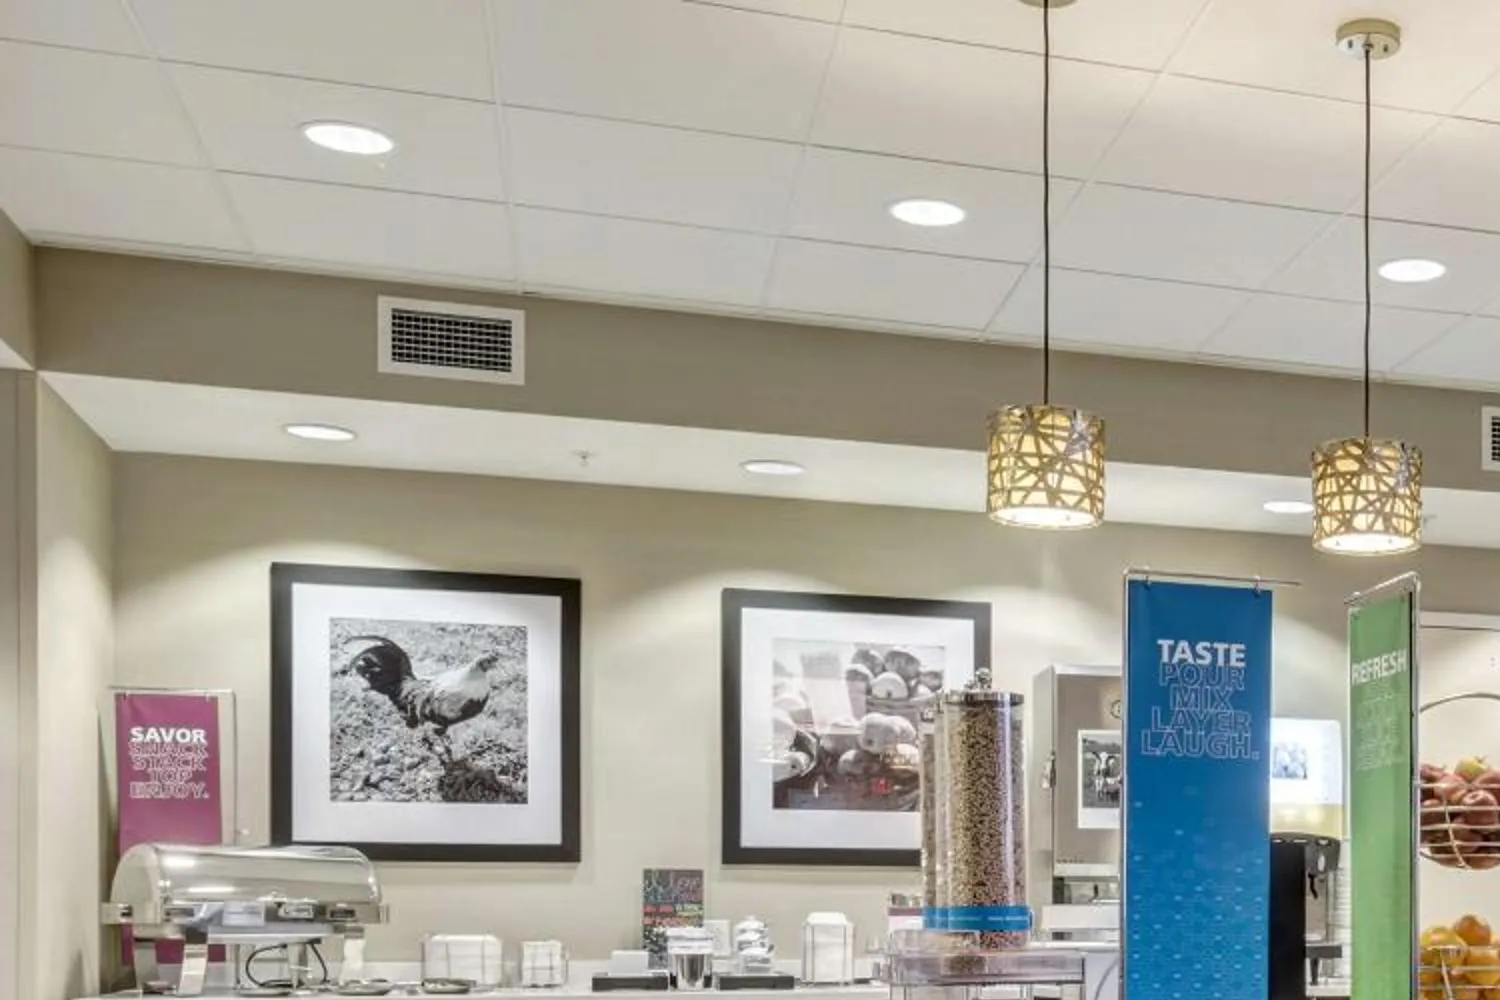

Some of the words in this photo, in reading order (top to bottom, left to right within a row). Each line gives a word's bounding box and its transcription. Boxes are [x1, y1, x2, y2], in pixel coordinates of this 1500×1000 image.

[1156, 638, 1246, 668] TASTE
[1351, 648, 1407, 686] REFRESH
[1158, 661, 1246, 691] POUR
[1169, 683, 1234, 711] MIX
[130, 726, 207, 743] SAVOR
[1151, 704, 1252, 737] LAYER
[1141, 728, 1260, 760] LAUGH.
[147, 767, 193, 784] TOP
